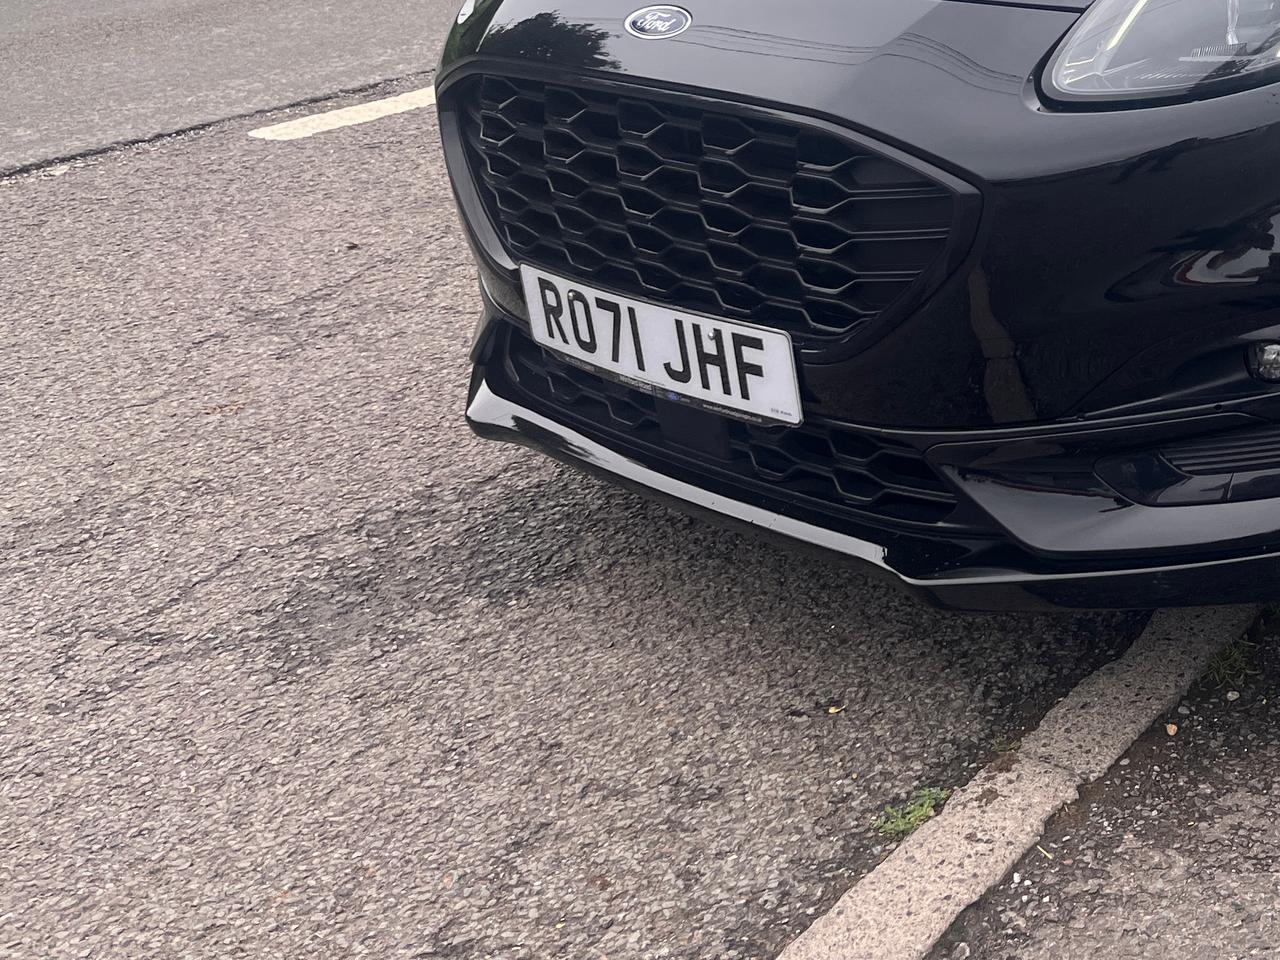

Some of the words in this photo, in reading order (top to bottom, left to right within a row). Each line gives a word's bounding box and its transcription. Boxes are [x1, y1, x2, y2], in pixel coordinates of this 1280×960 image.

[637, 11, 677, 32] Ford
[537, 276, 646, 372] RO71
[663, 318, 765, 401] JHF
